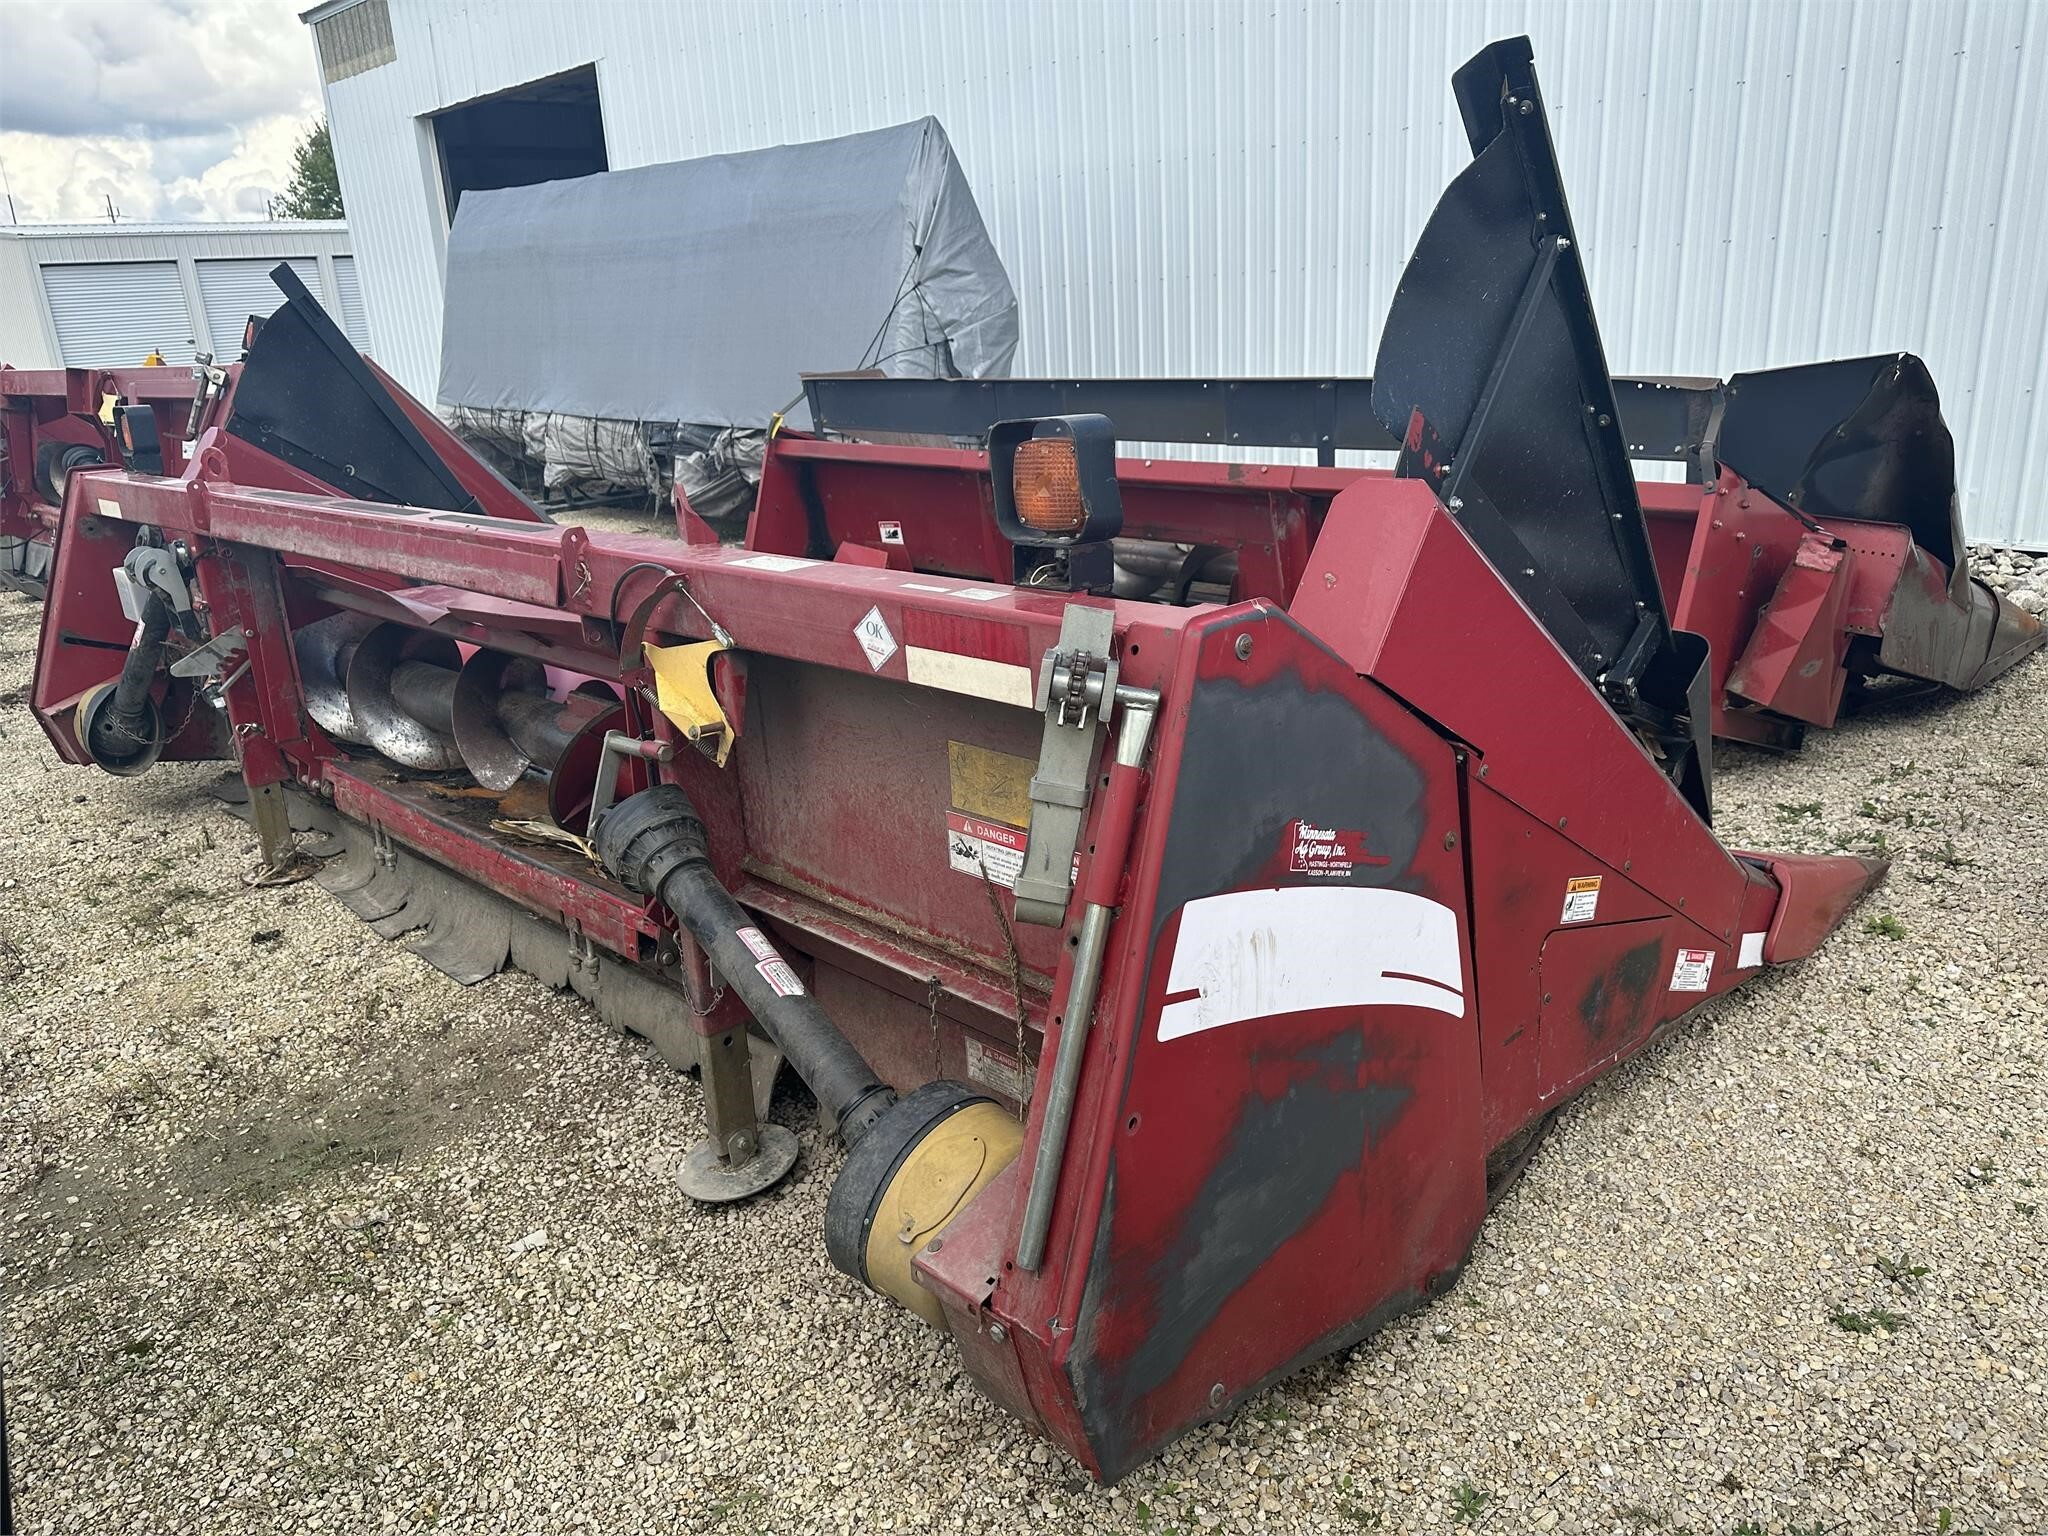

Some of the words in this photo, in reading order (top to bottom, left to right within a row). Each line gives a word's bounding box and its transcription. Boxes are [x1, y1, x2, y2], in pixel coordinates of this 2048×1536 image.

[866, 621, 884, 640] OK
[977, 826, 1016, 846] DANGER
[1299, 825, 1336, 841] Minnesota
[1295, 841, 1309, 858] Ag
[1308, 841, 1332, 859] Group,
[1332, 843, 1346, 857] Inc.
[1577, 881, 1598, 890] WARNING
[1691, 953, 1706, 961] DANGER
